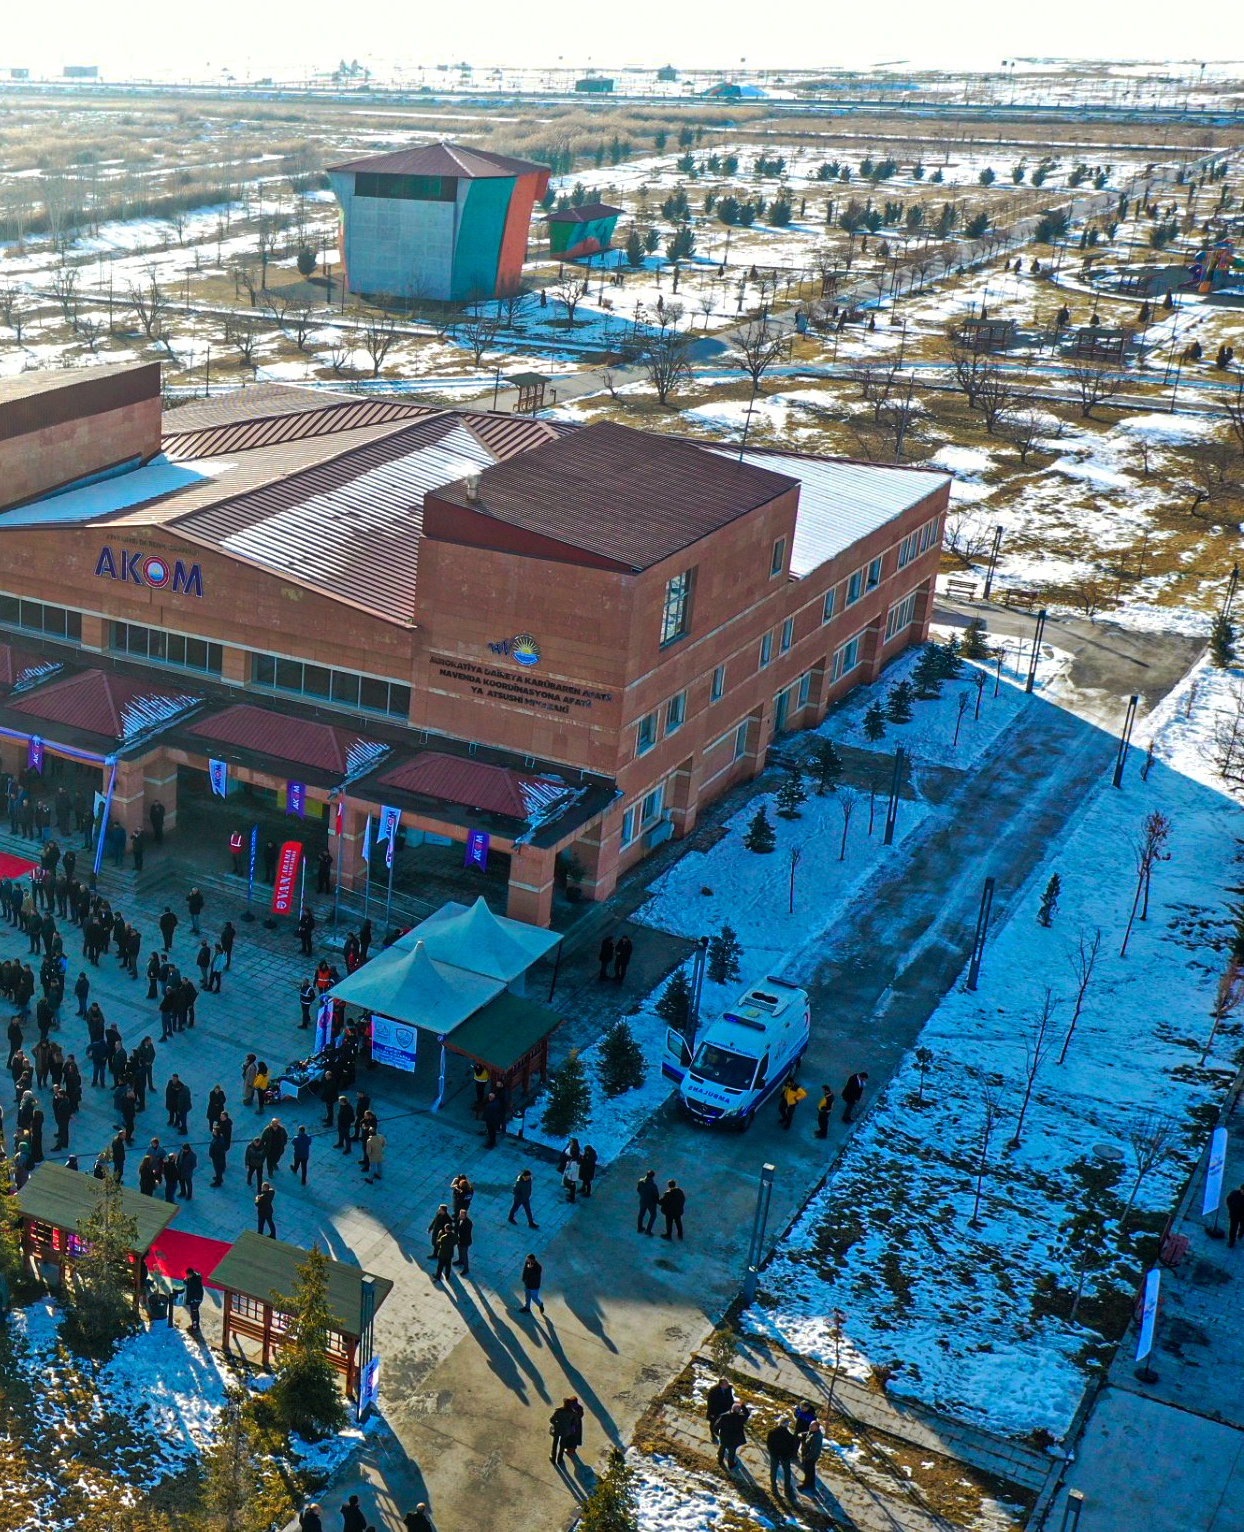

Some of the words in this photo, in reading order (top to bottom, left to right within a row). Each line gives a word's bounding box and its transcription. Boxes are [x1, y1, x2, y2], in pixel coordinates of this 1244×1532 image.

[93, 545, 203, 598] AKOM
[439, 669, 481, 684] NAVENDA
[471, 686, 483, 694] YA
[385, 811, 395, 837] AKOM
[474, 835, 483, 861] AKOM
[277, 875, 291, 900] VAN
